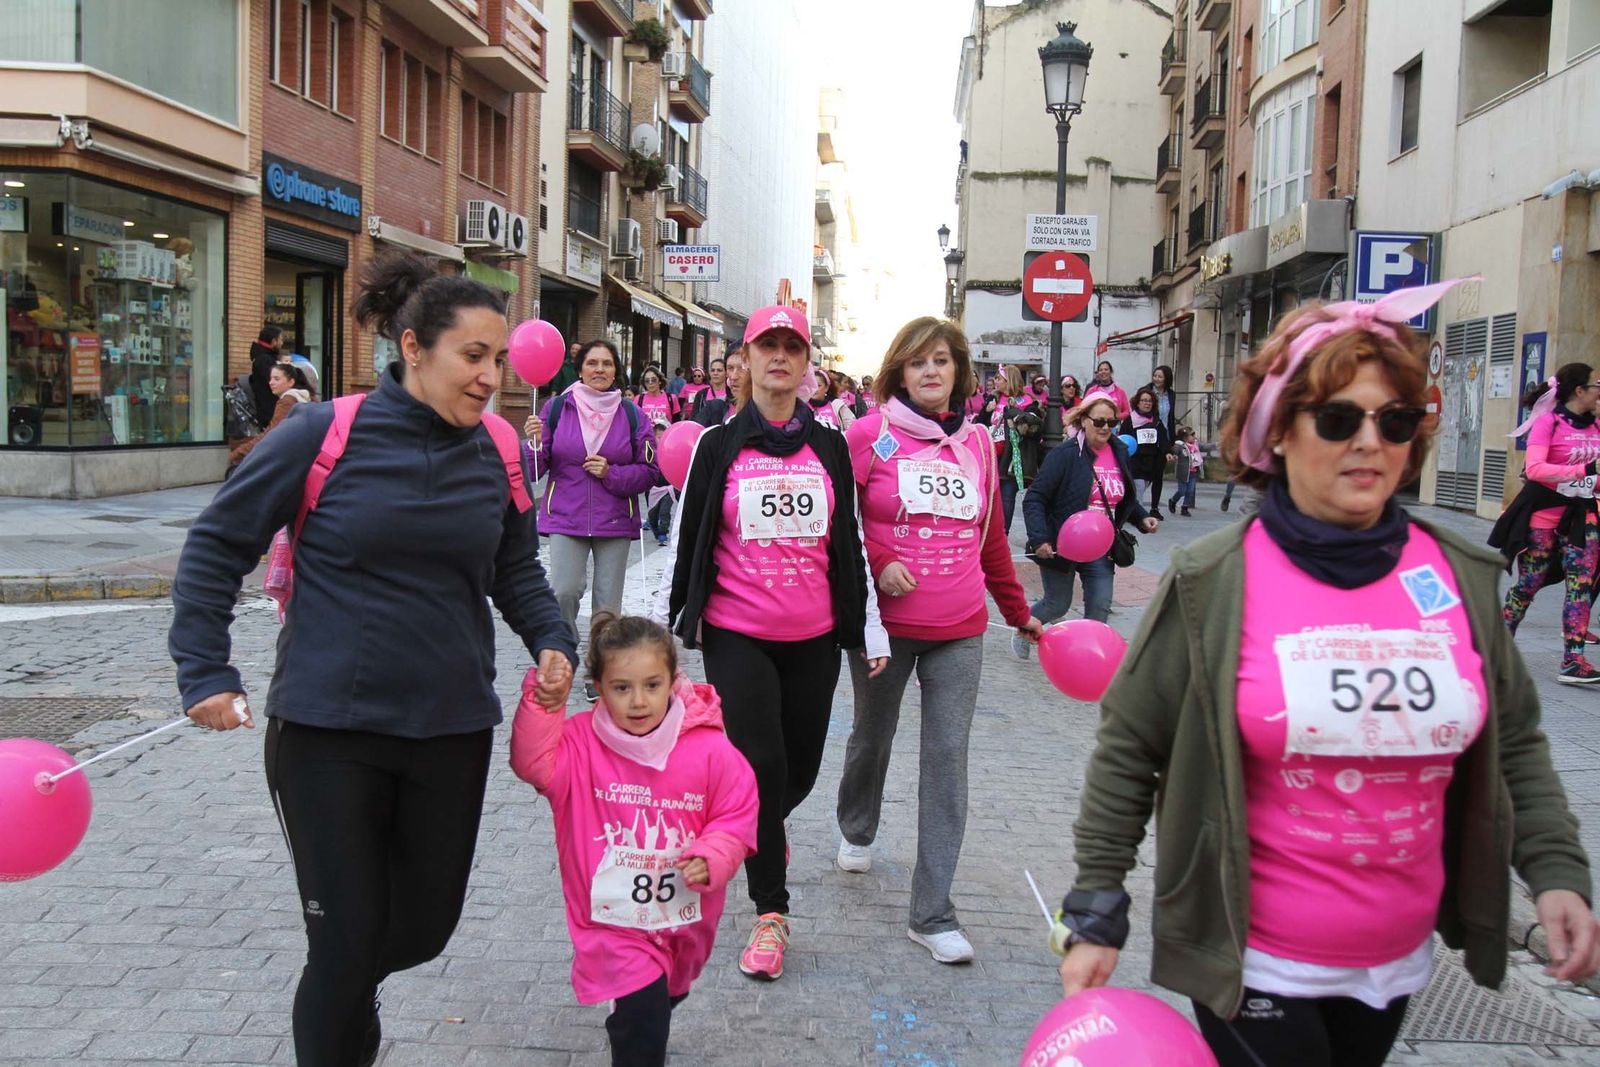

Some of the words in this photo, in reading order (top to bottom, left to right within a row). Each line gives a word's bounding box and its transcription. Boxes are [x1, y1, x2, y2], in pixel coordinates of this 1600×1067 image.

[328, 187, 360, 217] store
[1035, 216, 1061, 225] EXCEPTO
[1062, 217, 1088, 226] GARAJES
[1033, 226, 1049, 234] SOLO
[1049, 227, 1061, 235] CON
[1081, 228, 1090, 236] VIA
[1031, 236, 1057, 245] CORTADA
[1067, 238, 1091, 246] TRAFICO
[668, 255, 714, 265] CASERO
[1368, 241, 1413, 290] P
[748, 457, 783, 465] CARRERA
[791, 464, 825, 475] RUNNING
[919, 475, 965, 499] 533
[761, 493, 813, 517] 539
[1315, 638, 1372, 649] CARRERA
[1292, 652, 1308, 661] DE
[1313, 650, 1329, 660] LA
[1331, 666, 1436, 712] 529
[609, 782, 652, 796] CARRERA
[684, 792, 705, 803] PINK
[605, 792, 616, 803] LA
[619, 794, 652, 807] MUJER
[661, 799, 703, 811] RUNNING
[619, 850, 656, 861] CARRERA
[615, 859, 626, 867] LA
[627, 860, 656, 870] MUJER
[631, 872, 676, 904] 85
